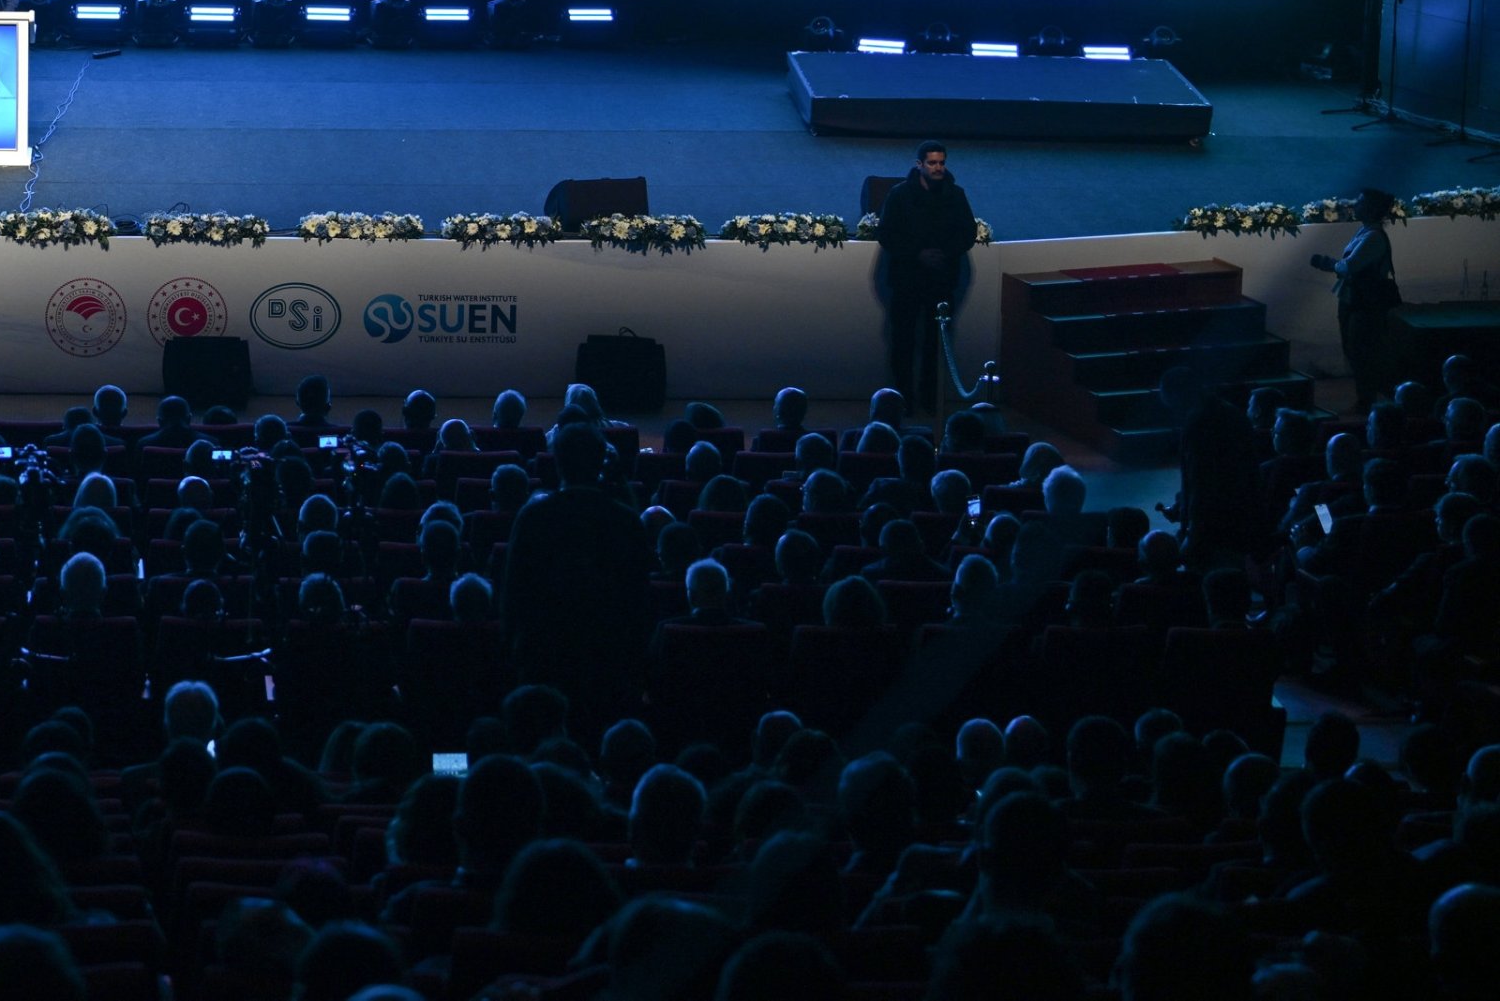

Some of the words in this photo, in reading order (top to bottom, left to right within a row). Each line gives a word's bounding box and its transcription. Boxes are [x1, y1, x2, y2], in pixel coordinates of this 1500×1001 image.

[418, 294, 452, 302] TURKISH
[479, 295, 518, 303] INSTITUTE
[417, 303, 518, 334] SUEN
[455, 335, 468, 344] SU
